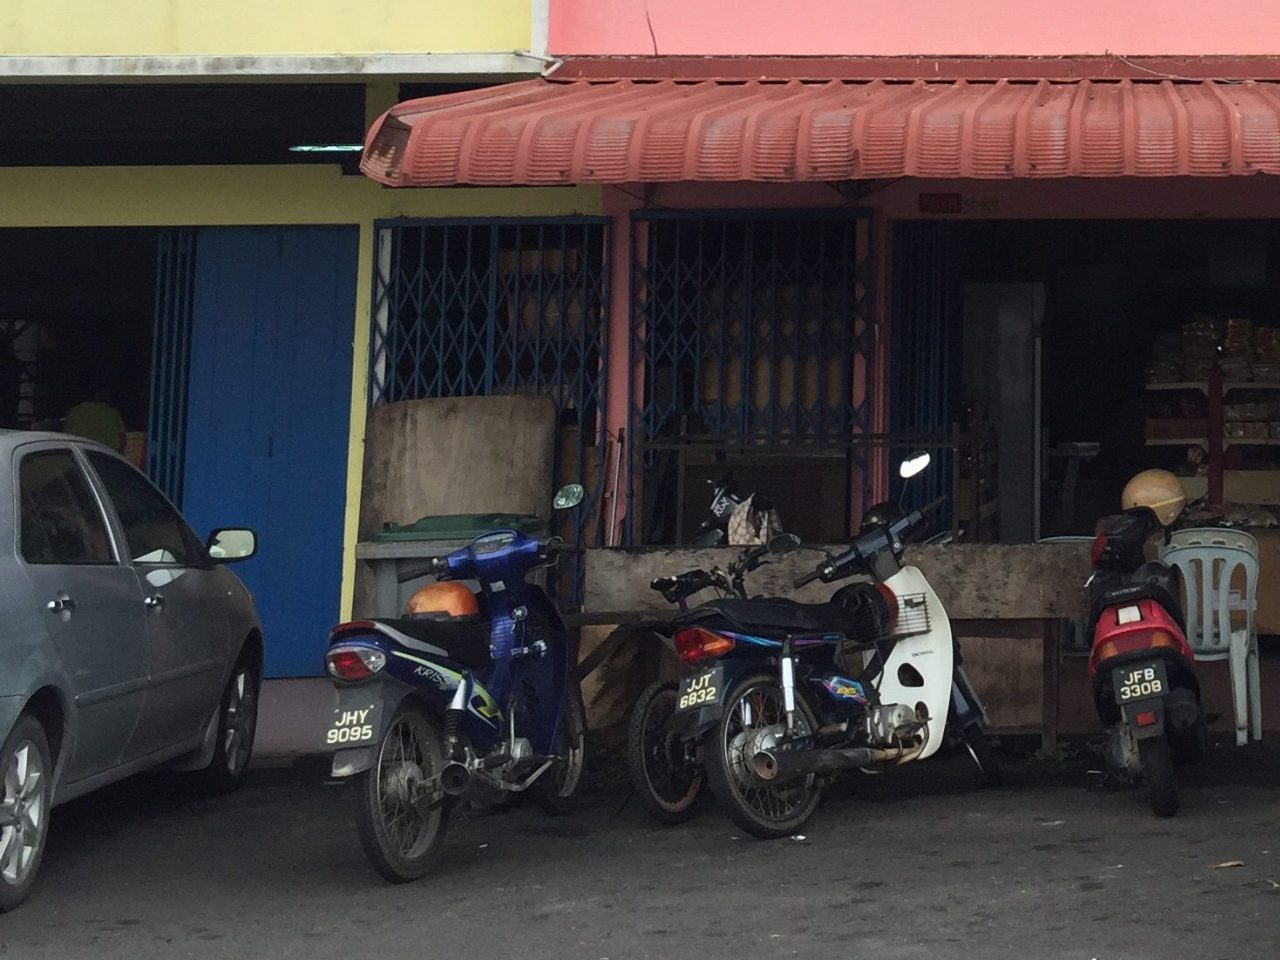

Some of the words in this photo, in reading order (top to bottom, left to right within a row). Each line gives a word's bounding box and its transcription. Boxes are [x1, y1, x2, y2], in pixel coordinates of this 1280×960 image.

[686, 673, 713, 694] JJT
[1123, 667, 1156, 686] JFB
[679, 686, 718, 710] 6832
[1120, 679, 1163, 700] 3308
[334, 708, 370, 727] JHY
[326, 724, 373, 744] 9095
